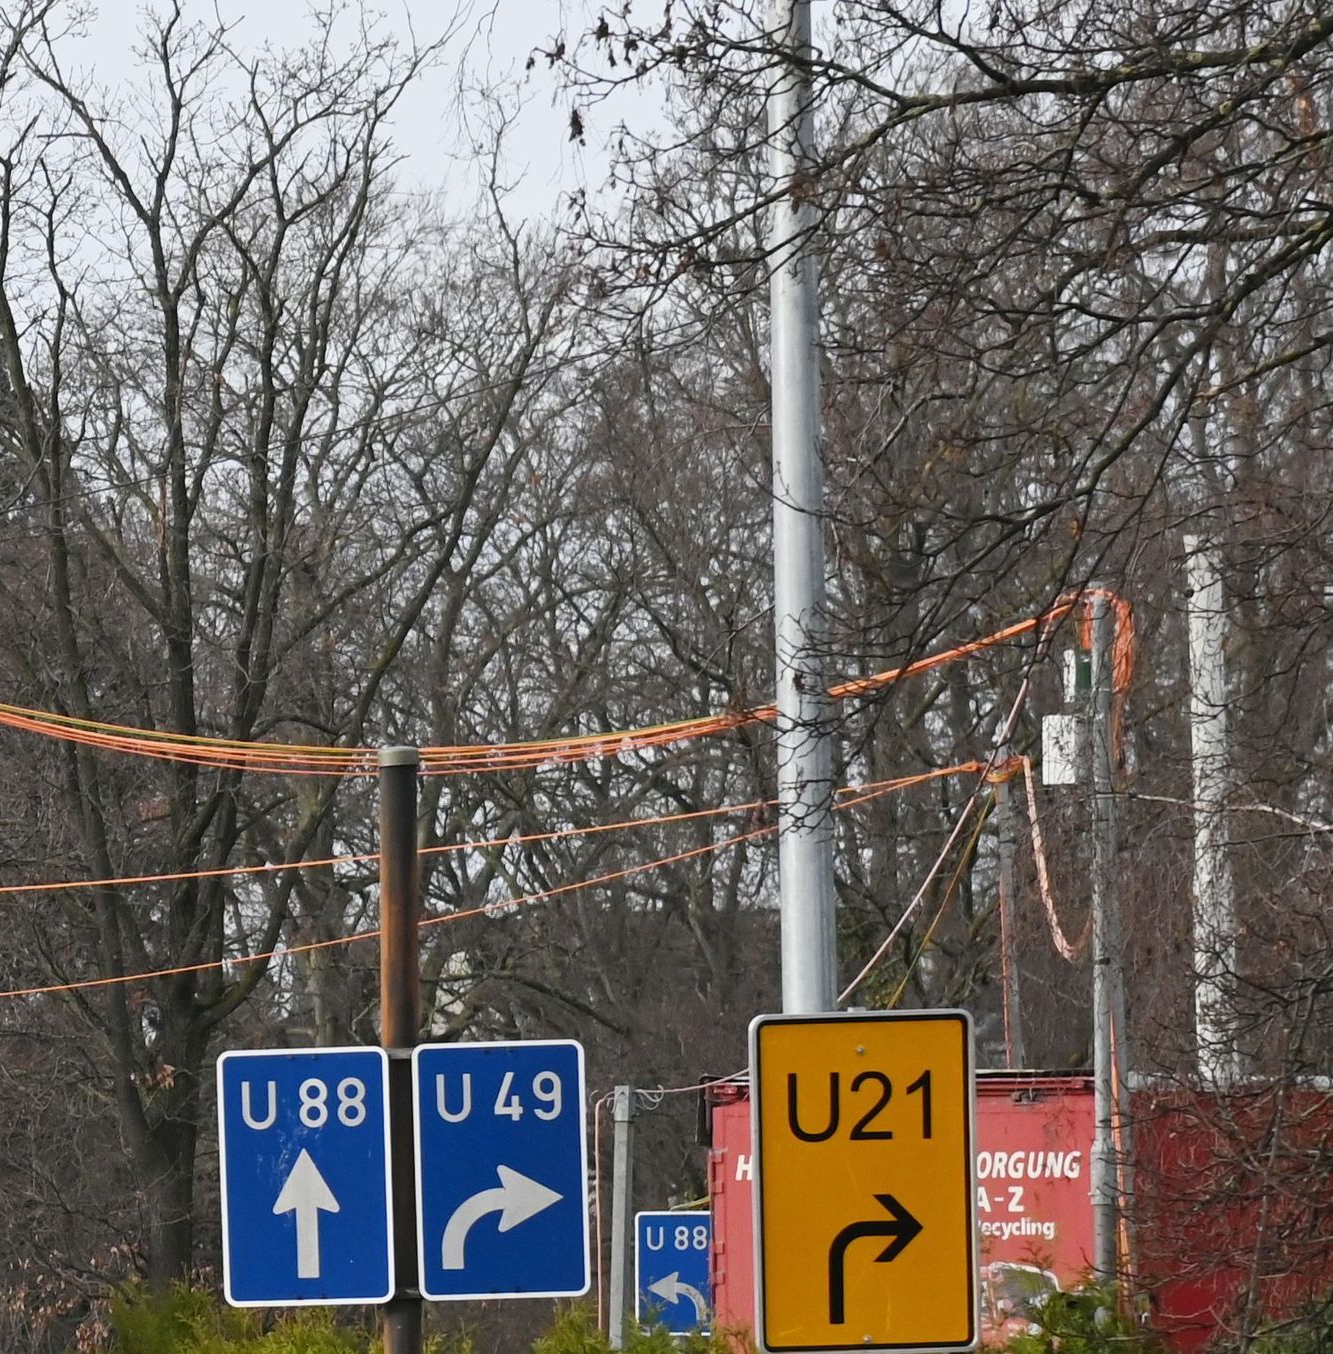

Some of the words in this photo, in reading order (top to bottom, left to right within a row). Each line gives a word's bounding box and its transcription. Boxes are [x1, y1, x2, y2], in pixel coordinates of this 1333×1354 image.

[241, 1081, 277, 1130] U
[298, 1076, 367, 1129] 88
[436, 1073, 472, 1123] U
[494, 1070, 563, 1121] 49
[786, 1069, 932, 1143] U21
[977, 1150, 1081, 1180] ORGUNG
[646, 1226, 664, 1251] U
[674, 1225, 707, 1251] 88
[978, 1217, 1055, 1240] ecycling
